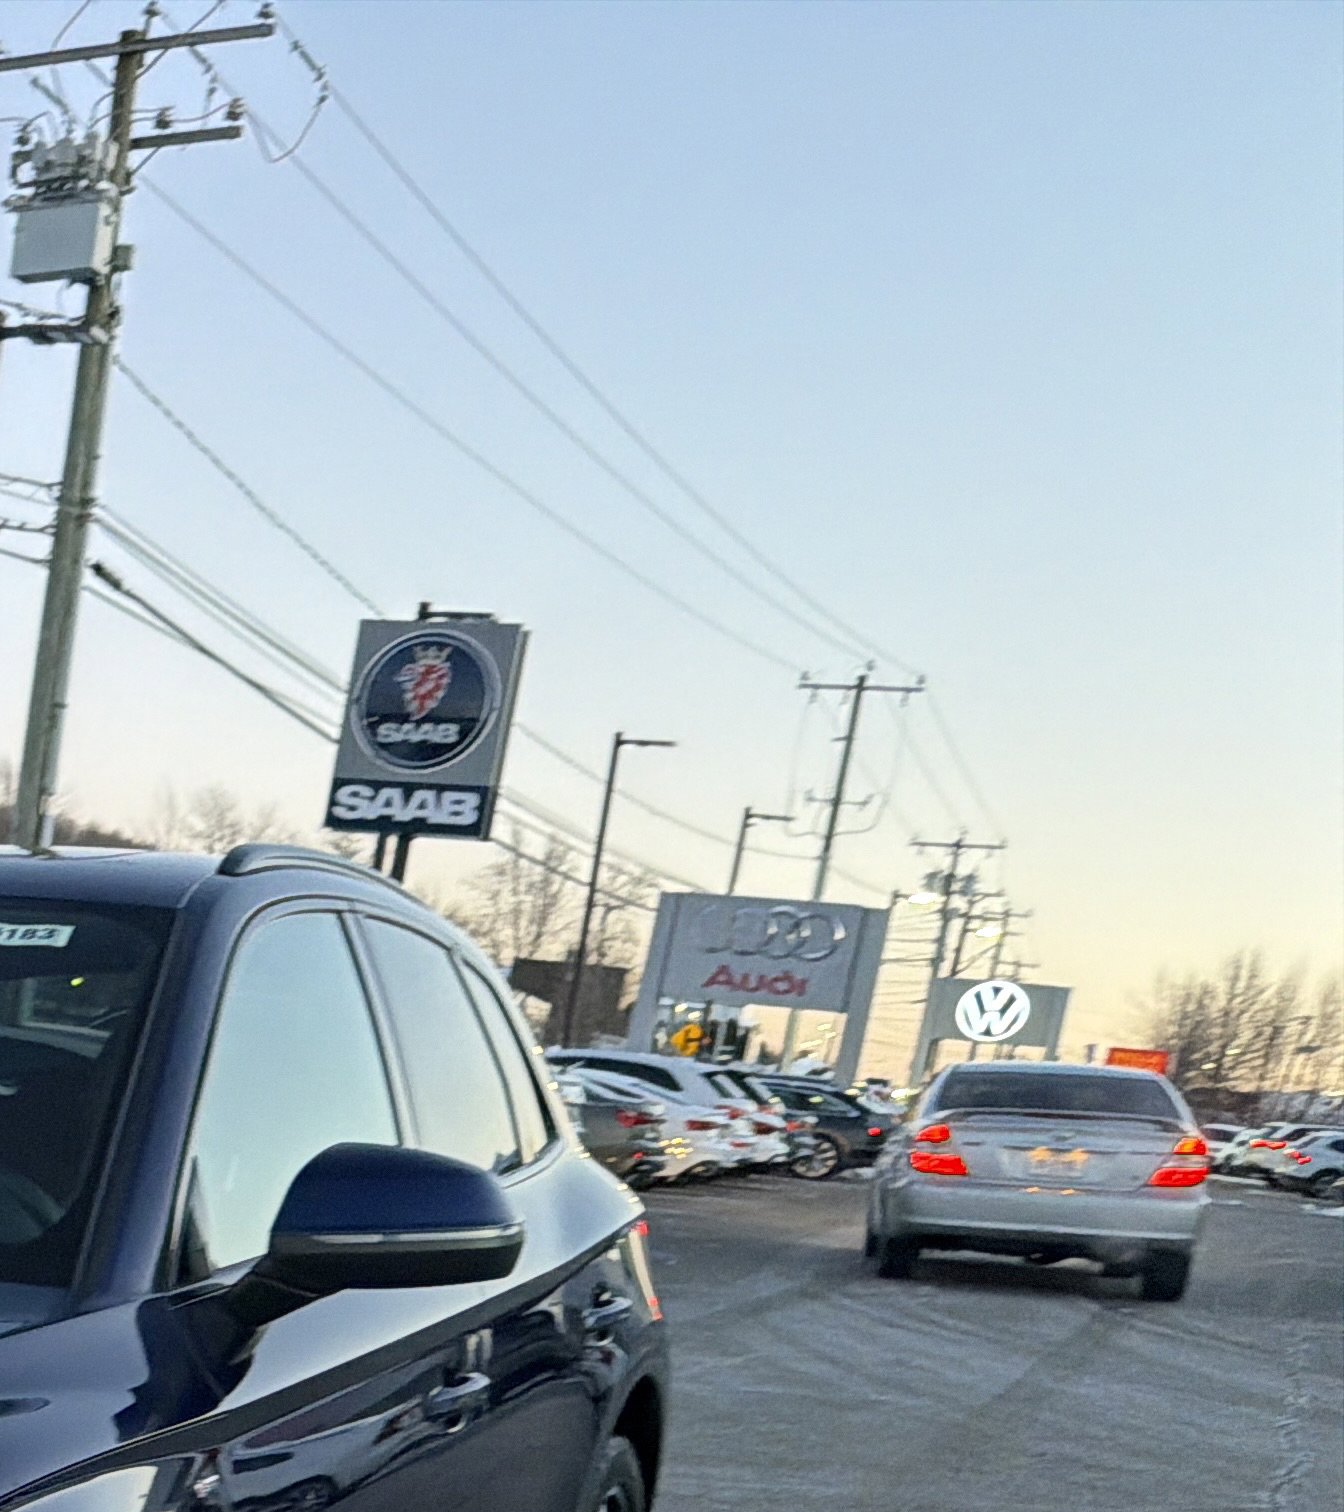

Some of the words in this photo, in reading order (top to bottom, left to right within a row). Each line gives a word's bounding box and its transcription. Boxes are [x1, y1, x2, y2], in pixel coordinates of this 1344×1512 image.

[376, 722, 460, 743] SAAB
[331, 784, 481, 825] SAAB
[701, 963, 809, 998] Audi
